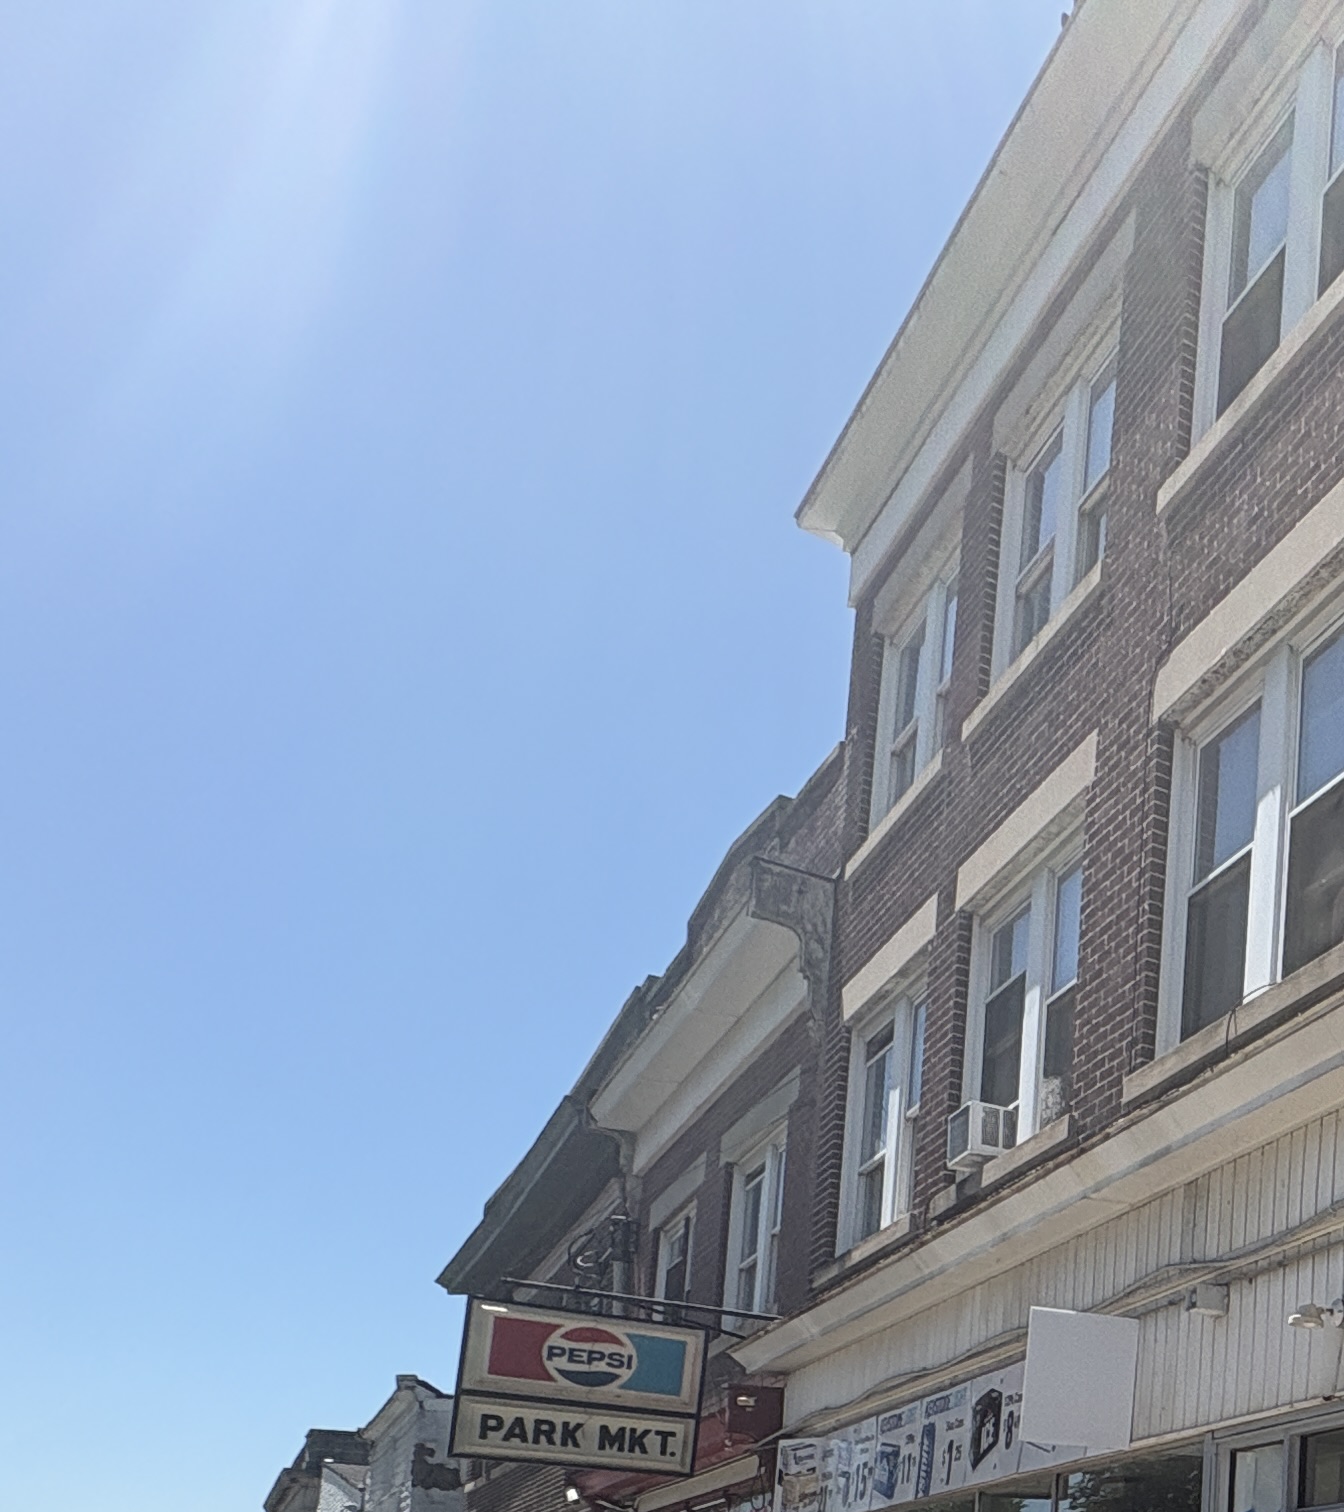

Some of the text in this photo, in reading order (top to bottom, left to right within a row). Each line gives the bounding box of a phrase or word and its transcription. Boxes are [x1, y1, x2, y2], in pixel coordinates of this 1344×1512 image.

[545, 1344, 634, 1371] PEPSI
[478, 1413, 677, 1458] PARK MKT.
